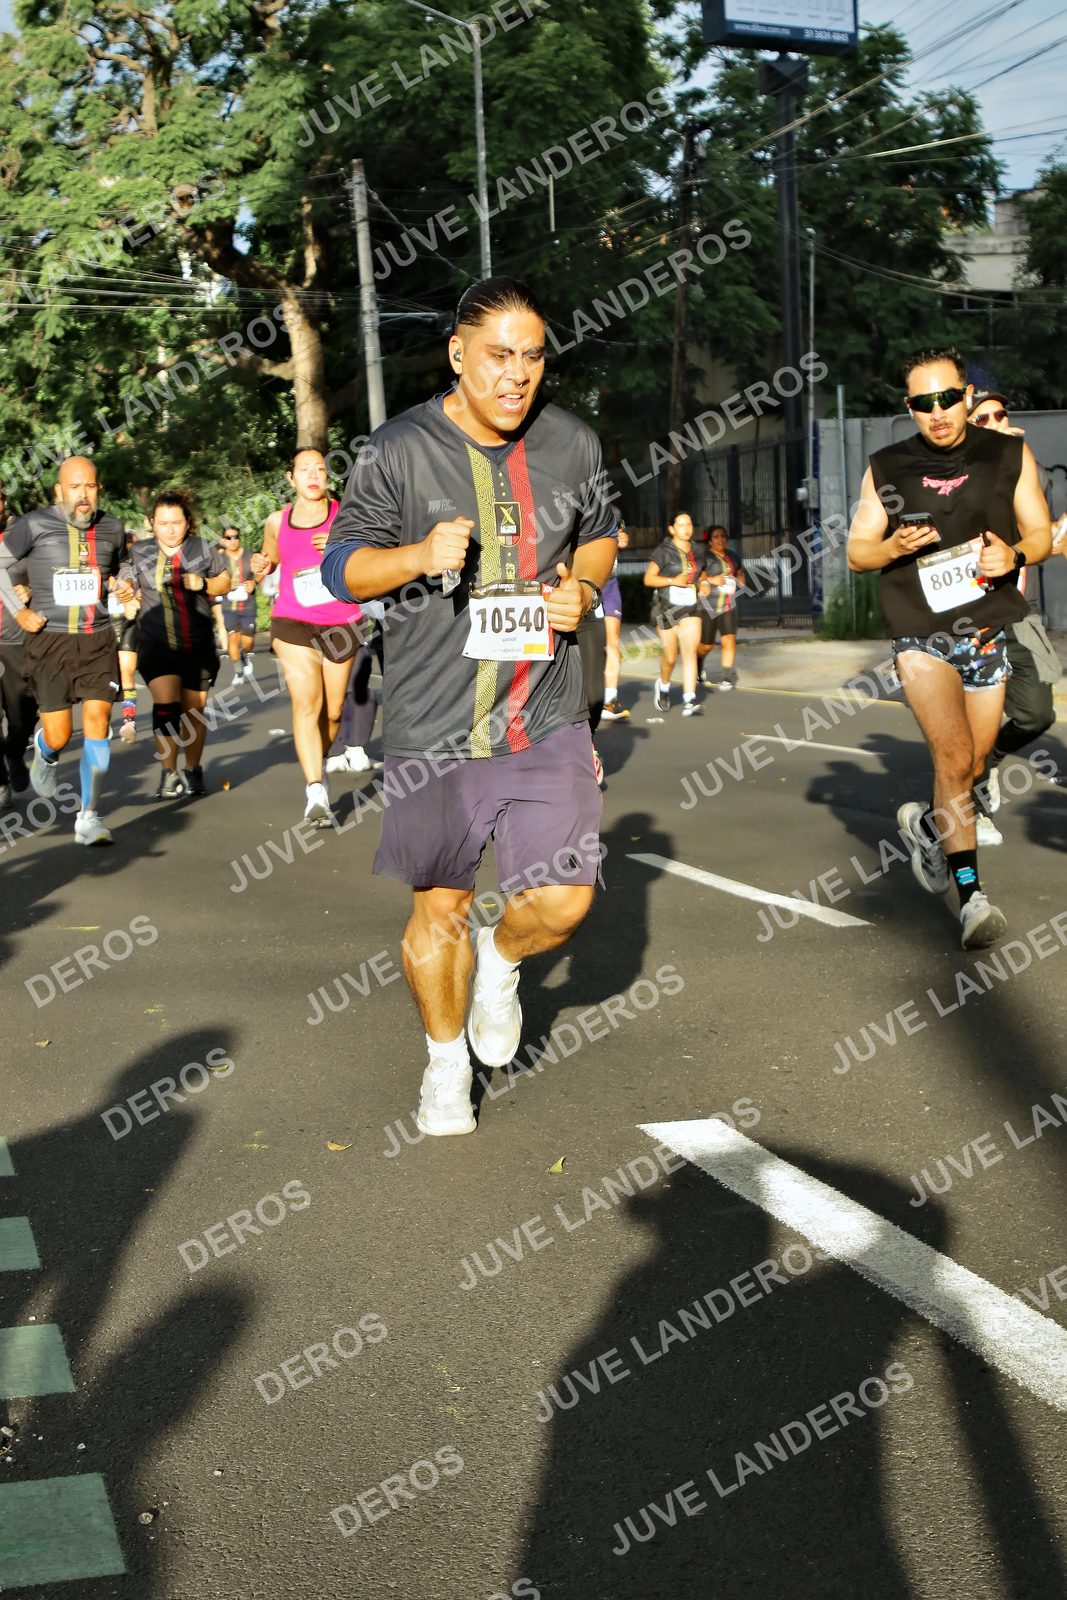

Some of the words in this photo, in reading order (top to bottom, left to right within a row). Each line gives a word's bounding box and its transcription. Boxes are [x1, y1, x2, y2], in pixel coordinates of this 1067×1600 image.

[57, 579, 95, 592] 13188
[930, 562, 977, 591] 8036
[476, 606, 545, 634] 10540
